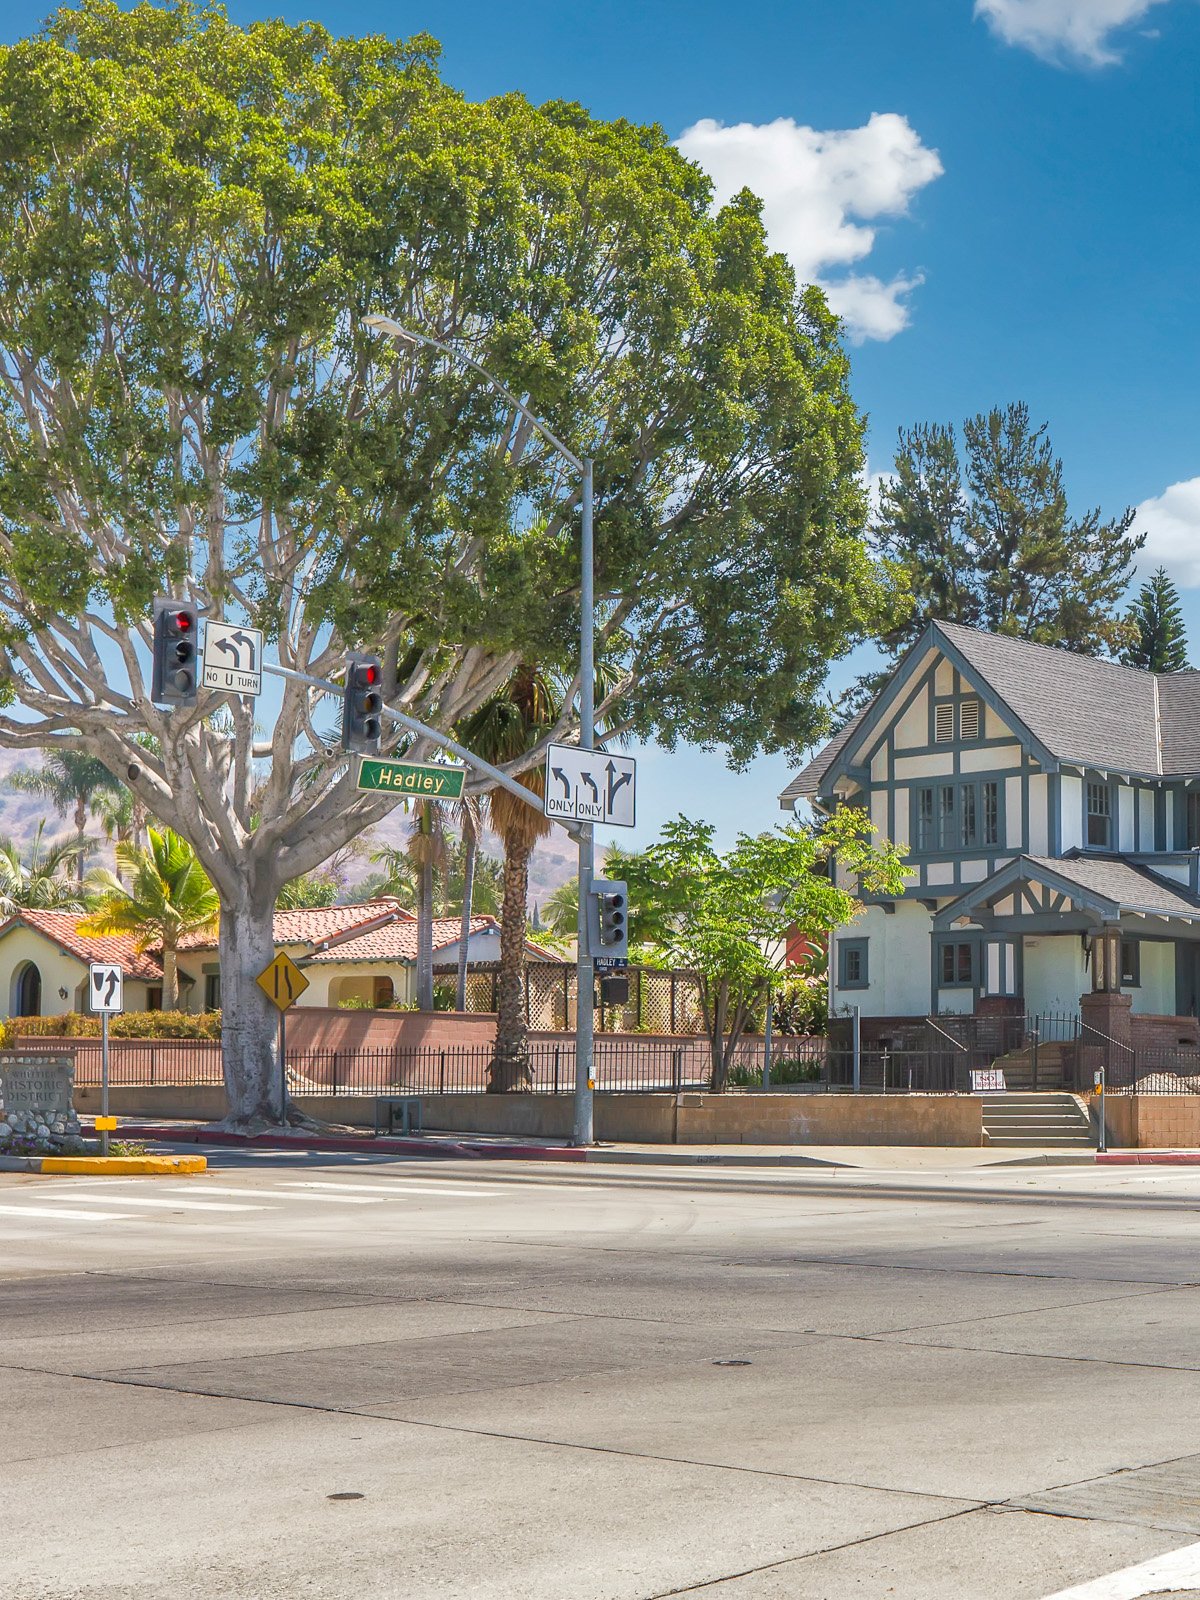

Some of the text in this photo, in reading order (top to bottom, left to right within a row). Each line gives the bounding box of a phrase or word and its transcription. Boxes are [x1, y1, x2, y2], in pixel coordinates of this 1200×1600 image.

[206, 672, 258, 688] NO U TURN
[378, 768, 445, 794] Hadley
[549, 799, 574, 812] ONLY
[579, 803, 602, 816] ONLY
[6, 1080, 63, 1090] HISTORIC
[8, 1092, 63, 1102] DISTRICT
